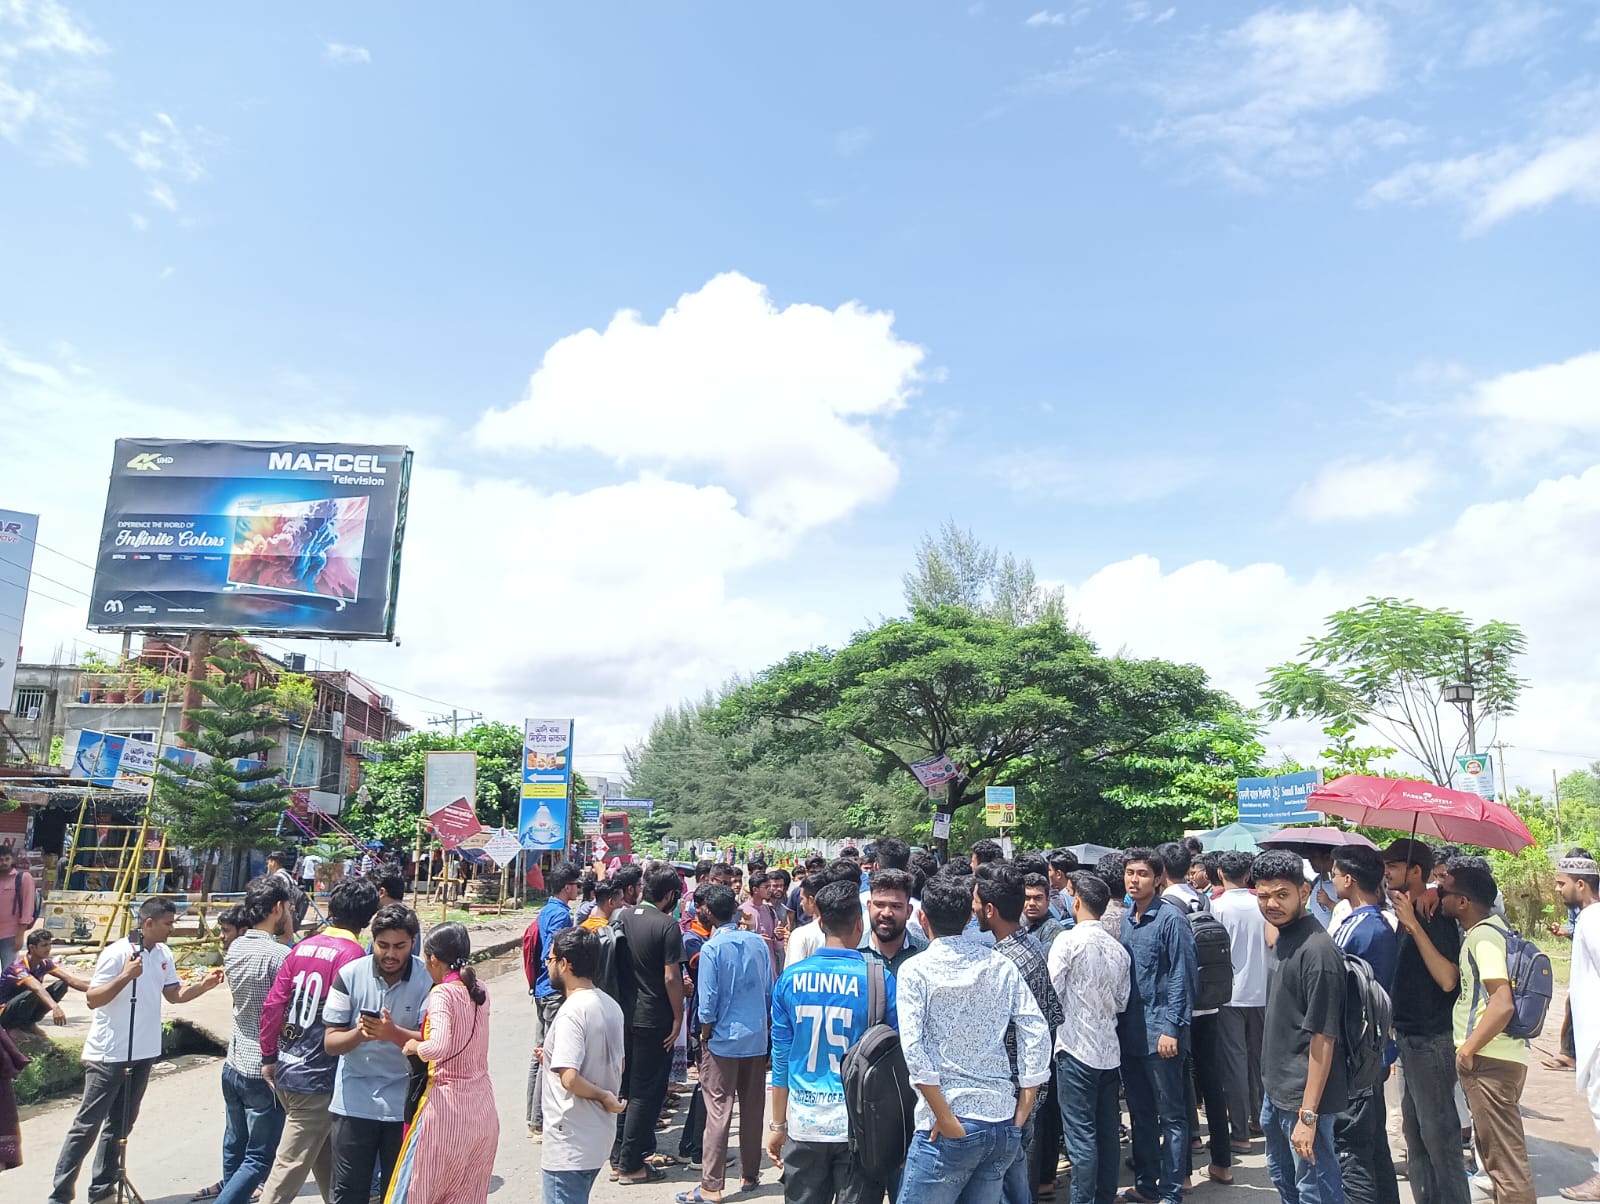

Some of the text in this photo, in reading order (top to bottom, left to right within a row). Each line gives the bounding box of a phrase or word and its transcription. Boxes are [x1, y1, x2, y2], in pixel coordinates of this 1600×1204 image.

[127, 453, 162, 471] 4K
[268, 452, 387, 473] MARCEL
[332, 474, 385, 486] Television
[163, 521, 185, 529] WORLD
[115, 529, 226, 548] Infinite Colors
[1294, 784, 1306, 795] Bank
[793, 972, 859, 997] MUNNA
[288, 970, 323, 1029] 10
[795, 1005, 853, 1074] 75
[827, 1091, 838, 1104] OF
